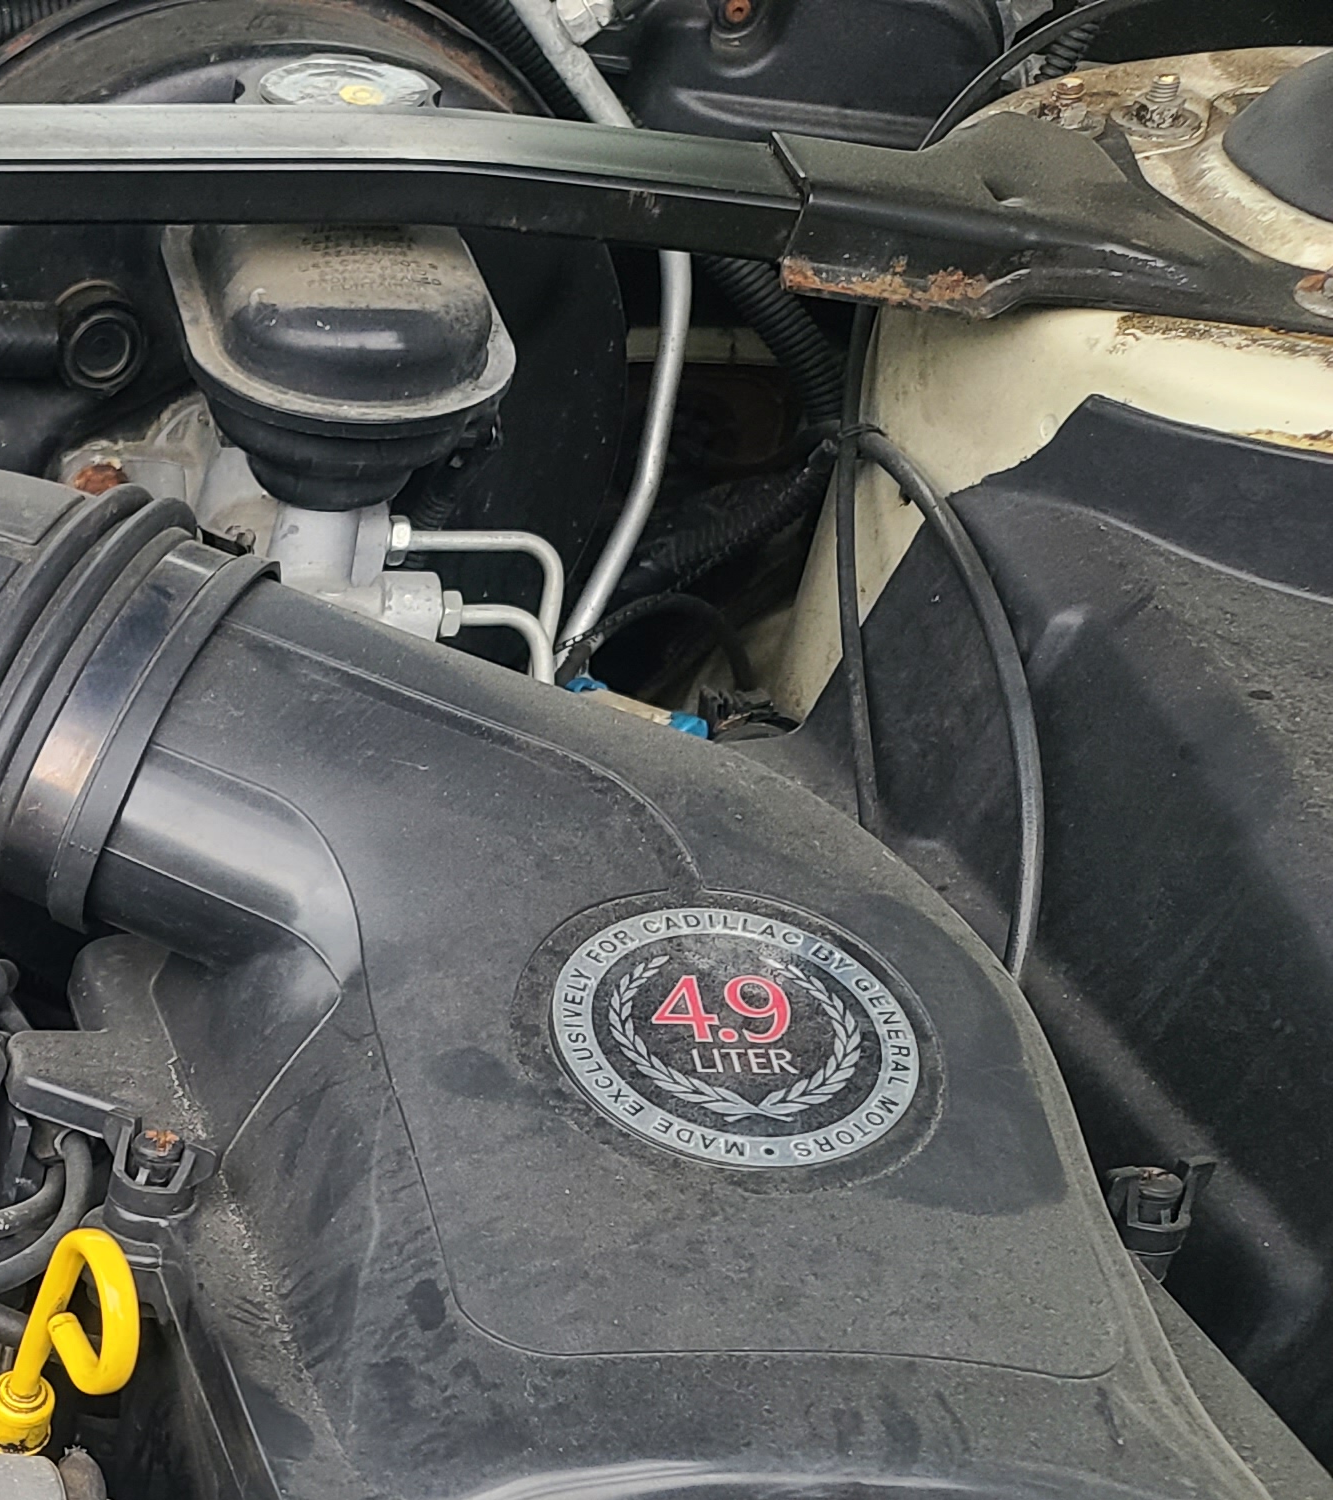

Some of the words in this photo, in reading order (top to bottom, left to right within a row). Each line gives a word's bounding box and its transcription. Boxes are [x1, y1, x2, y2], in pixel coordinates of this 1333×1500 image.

[585, 930, 637, 964] FOR
[640, 914, 802, 946] CADILLAC
[809, 942, 856, 973] BY
[652, 975, 791, 1043] 4.9
[563, 968, 645, 1117] EXCLUSIVELY
[851, 977, 912, 1086] GENERAL
[692, 1048, 798, 1075] LITER
[652, 1115, 750, 1157] MADE
[792, 1096, 903, 1158] MOTORS
